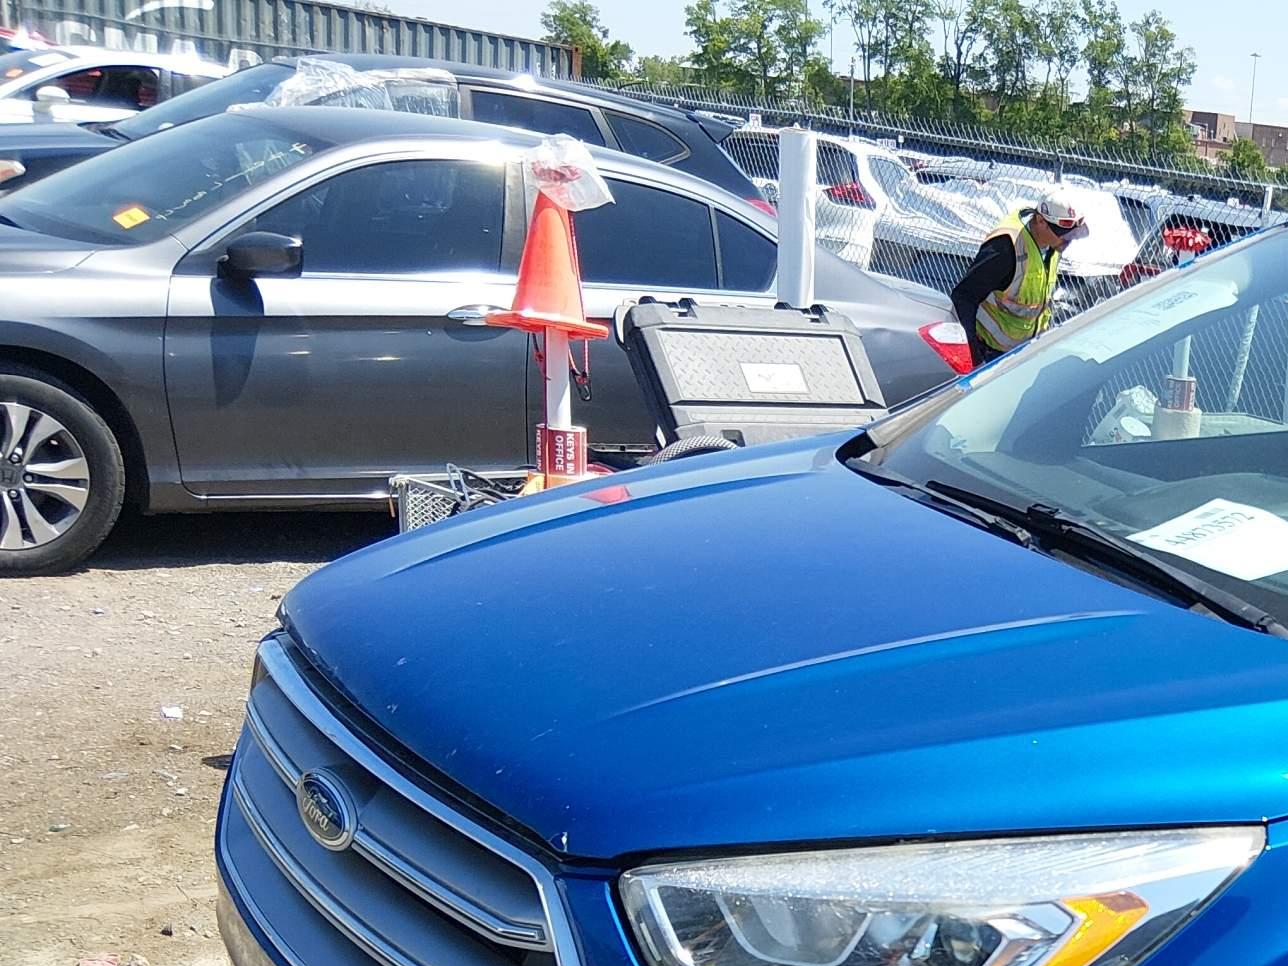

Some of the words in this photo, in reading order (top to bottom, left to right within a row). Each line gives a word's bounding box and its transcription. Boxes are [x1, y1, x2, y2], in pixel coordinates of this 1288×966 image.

[555, 435, 564, 471] OFFICE
[566, 433, 575, 460] KEYS
[566, 463, 575, 475] IN
[1165, 511, 1256, 547] 44873572
